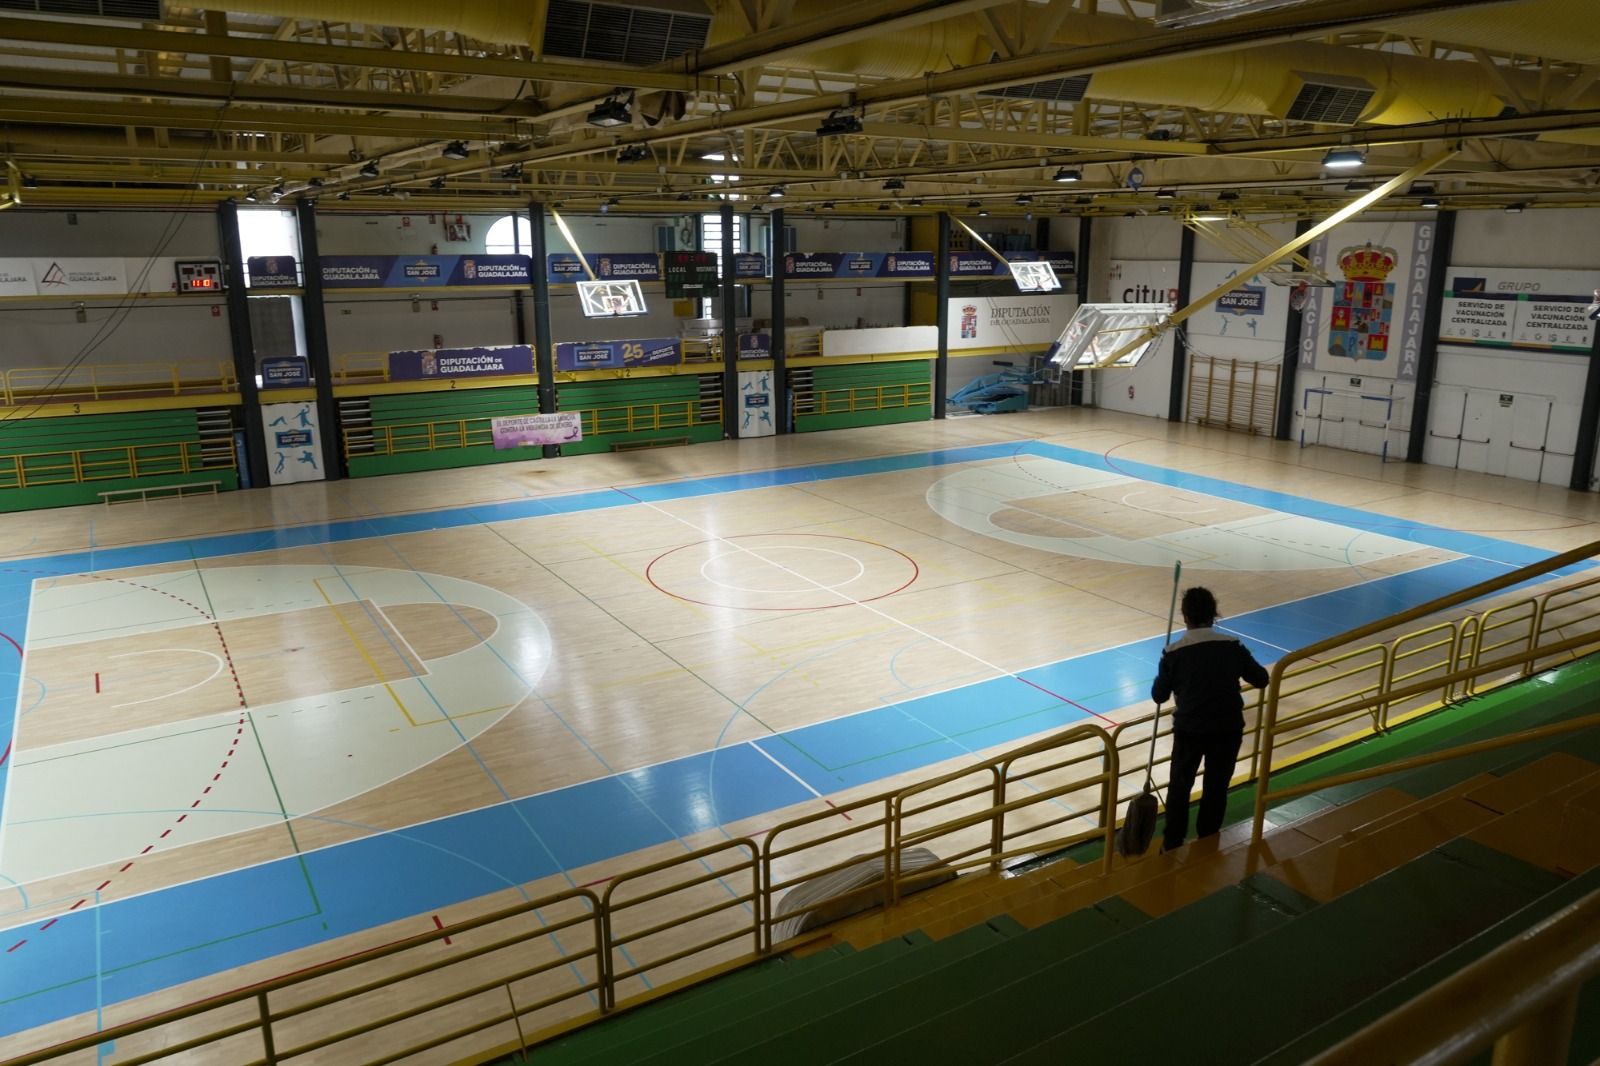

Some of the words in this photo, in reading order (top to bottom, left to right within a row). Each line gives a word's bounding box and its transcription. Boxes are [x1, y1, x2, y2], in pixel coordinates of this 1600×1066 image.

[1497, 281, 1543, 293] GRUPO
[1221, 297, 1237, 305] SAN
[1237, 297, 1259, 307] JOSÉ
[1402, 225, 1431, 376] GUADALAJARA
[1458, 301, 1493, 310] SERVICIO
[991, 304, 1050, 319] DIPUTACIÓN
[1533, 305, 1573, 314] SERVICIO
[1574, 306, 1585, 314] DE
[1000, 317, 1050, 325] GUADALAJARA
[1451, 317, 1507, 327] CENTRALIZADA
[1526, 321, 1588, 331] CENTRALIZADA
[622, 343, 644, 359] 25
[439, 355, 493, 366] DIPUTACIÓN
[440, 363, 505, 373] GUADALAJARA
[626, 369, 631, 377] 2
[450, 380, 456, 389] 2
[73, 403, 81, 414] 3
